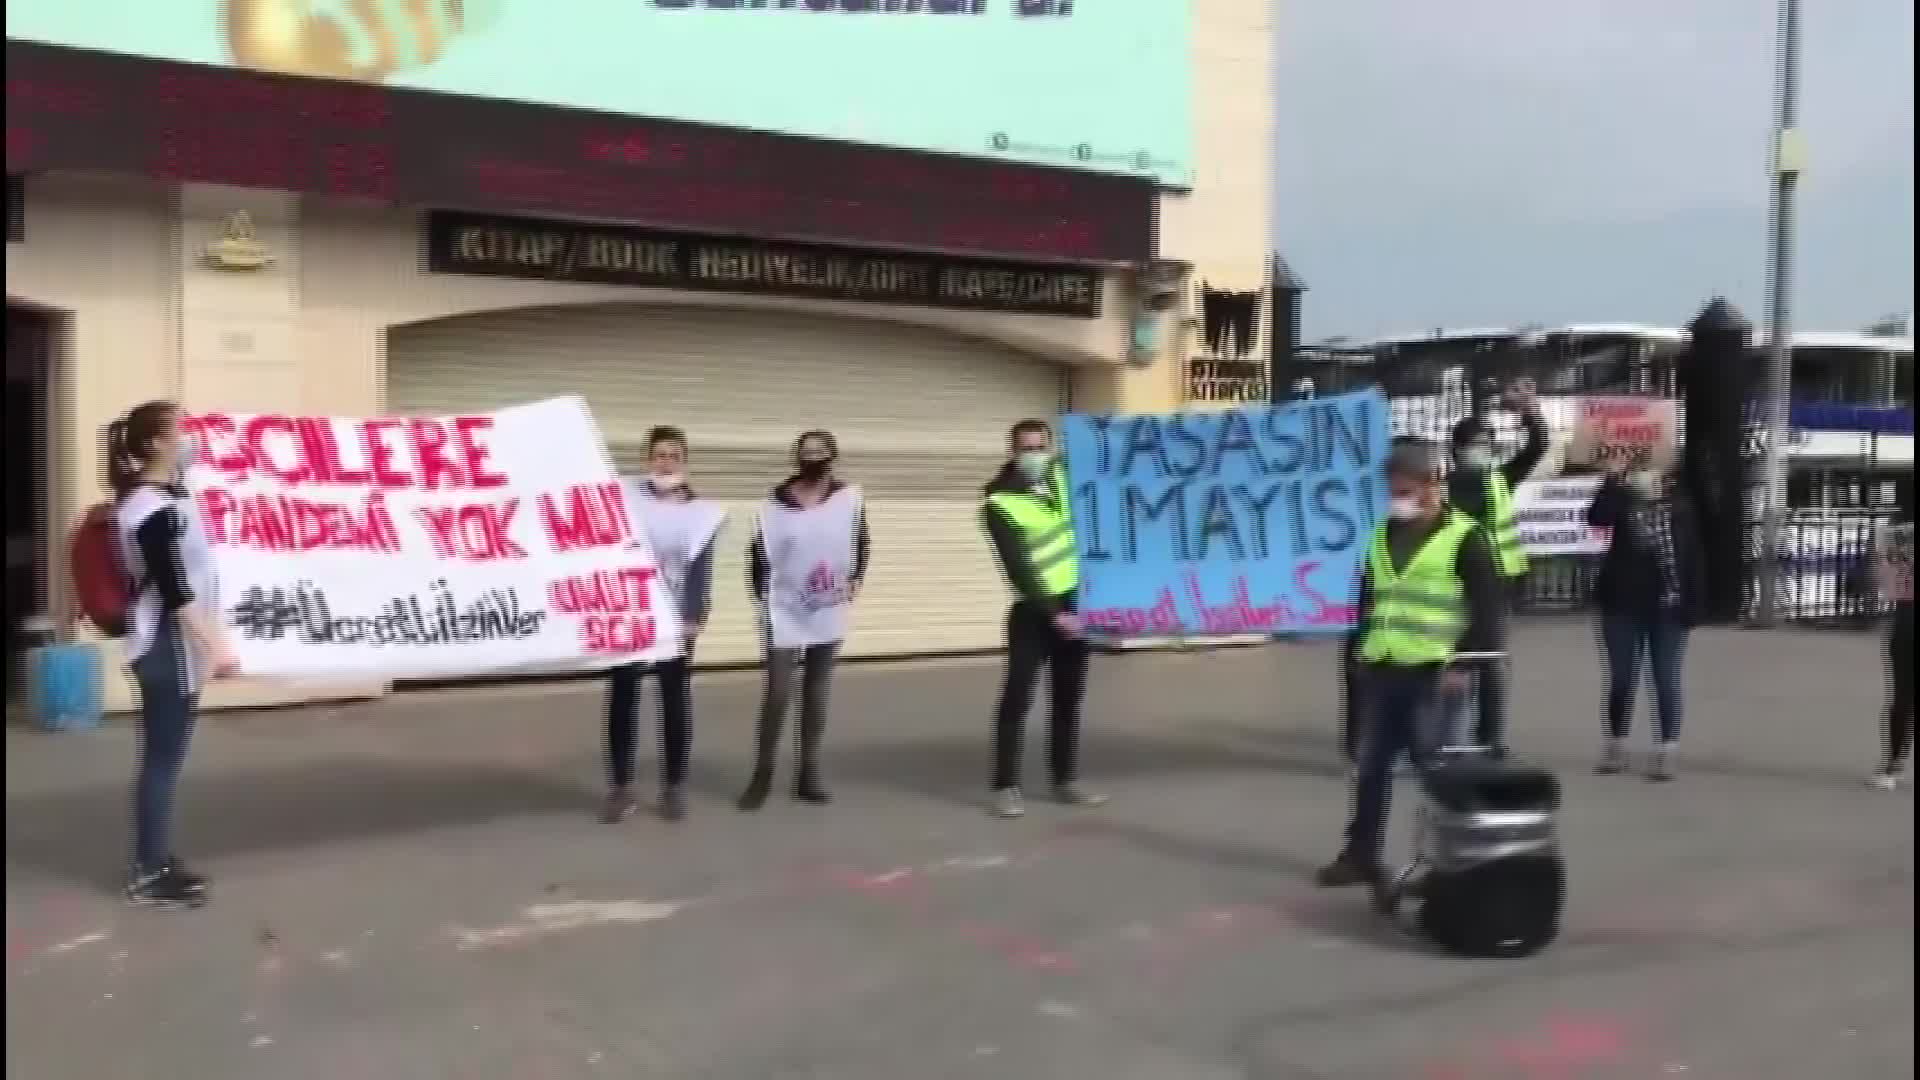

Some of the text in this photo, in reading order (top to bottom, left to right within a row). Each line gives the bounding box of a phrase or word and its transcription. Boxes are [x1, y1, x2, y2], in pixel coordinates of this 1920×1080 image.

[418, 498, 528, 560] YOK
[1078, 480, 1113, 562] 1
[551, 568, 657, 613] UMUT
[580, 613, 657, 653] SEN
